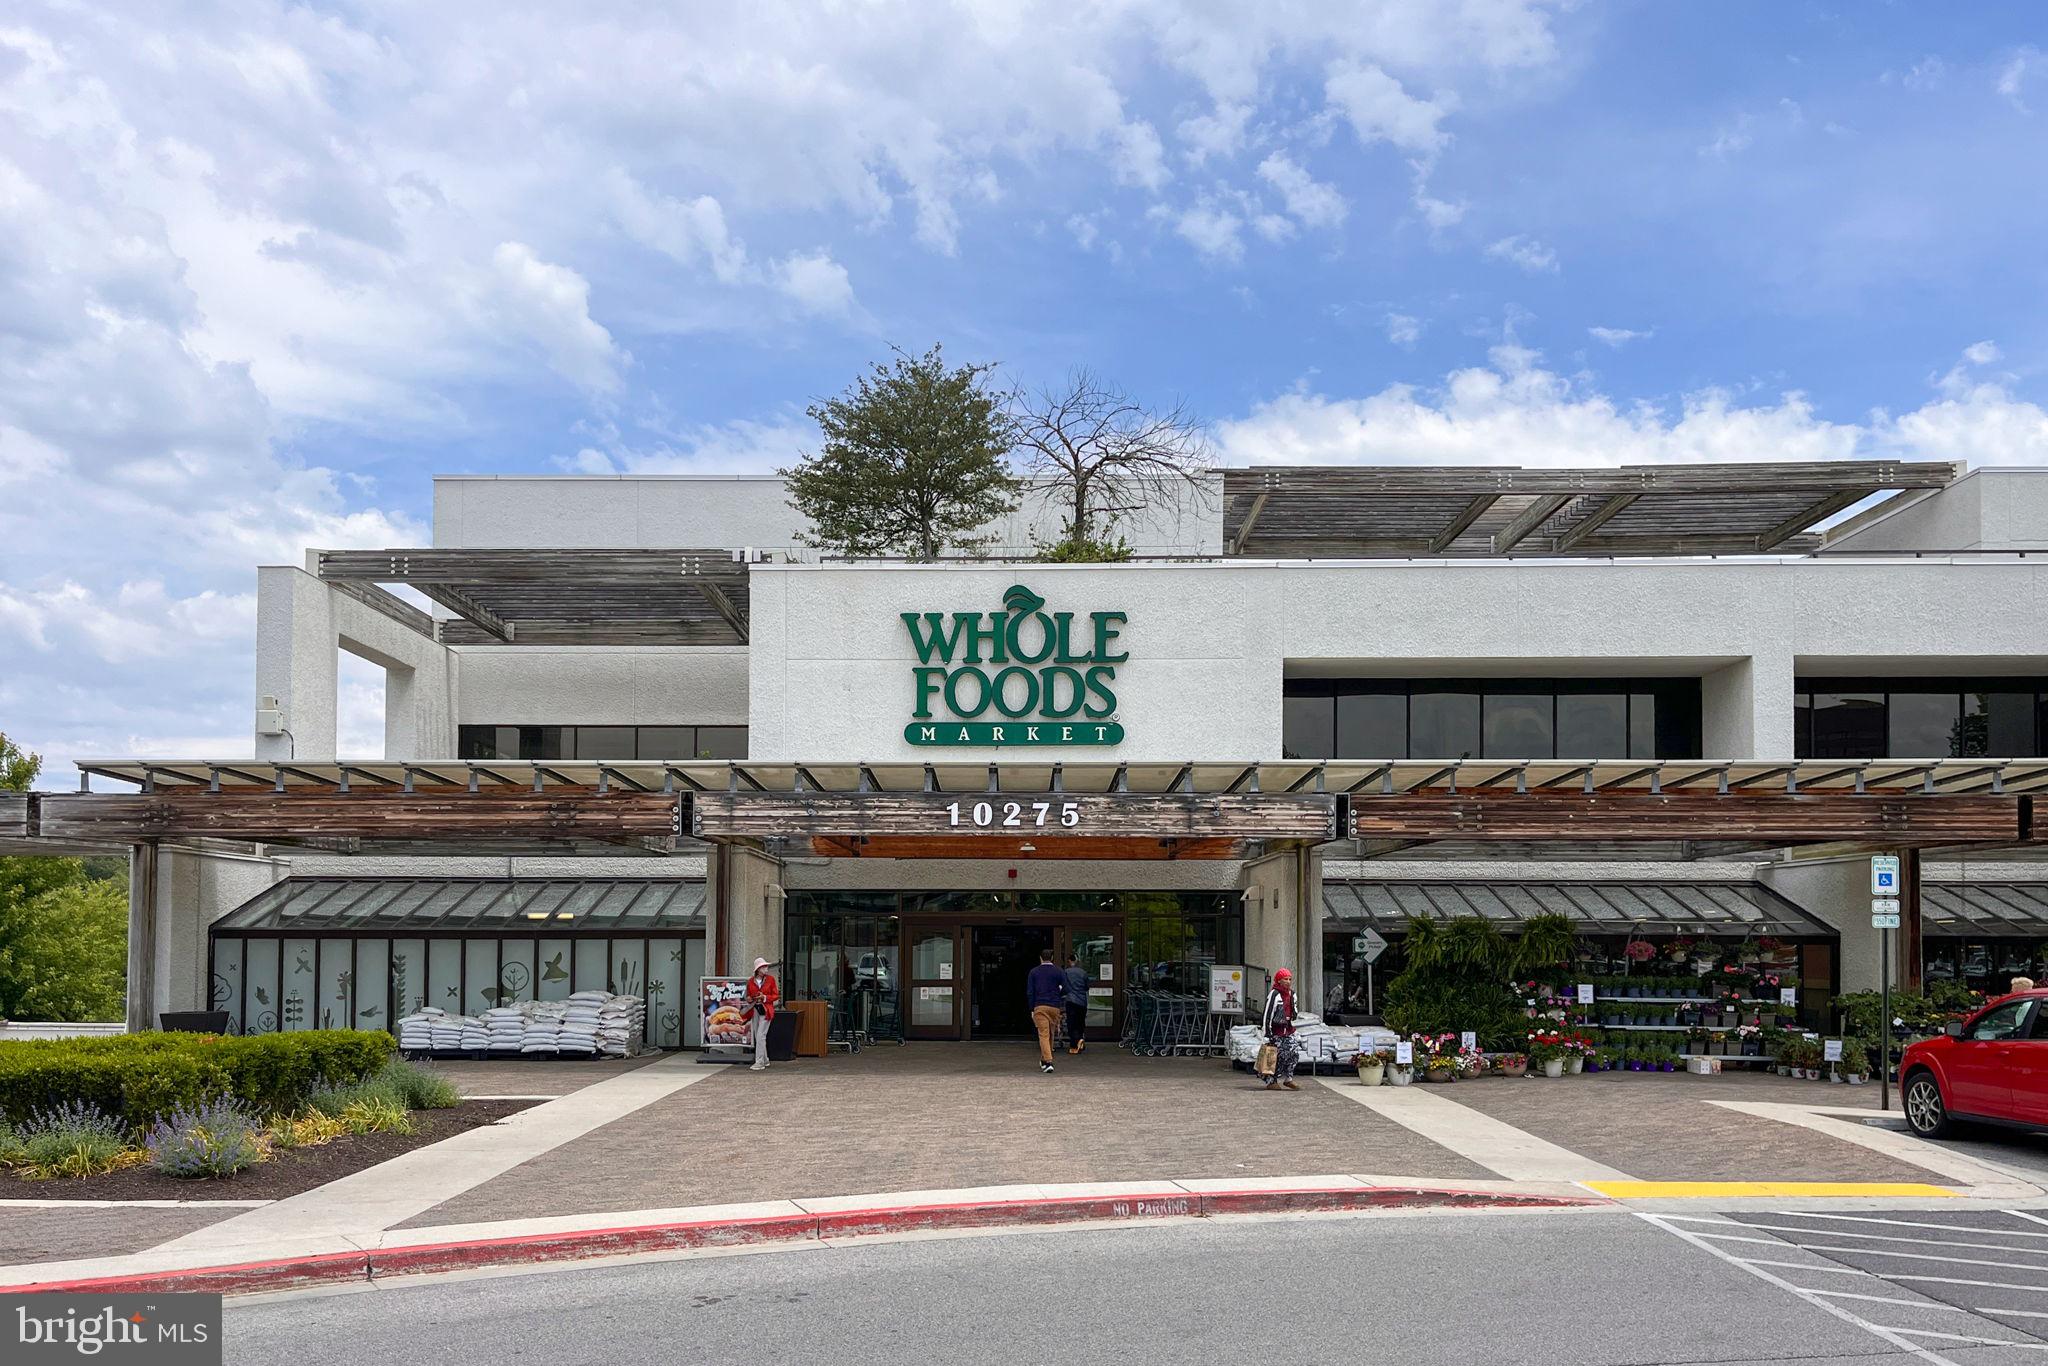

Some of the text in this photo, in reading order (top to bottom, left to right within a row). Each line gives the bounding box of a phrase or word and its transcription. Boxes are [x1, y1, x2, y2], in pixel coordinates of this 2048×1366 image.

[900, 609, 1129, 665] WHOLE
[912, 666, 1117, 718] FOODS
[921, 726, 1107, 741] MARKET
[946, 802, 1080, 827] 10275
[1113, 1200, 1188, 1216] NO PARKING
